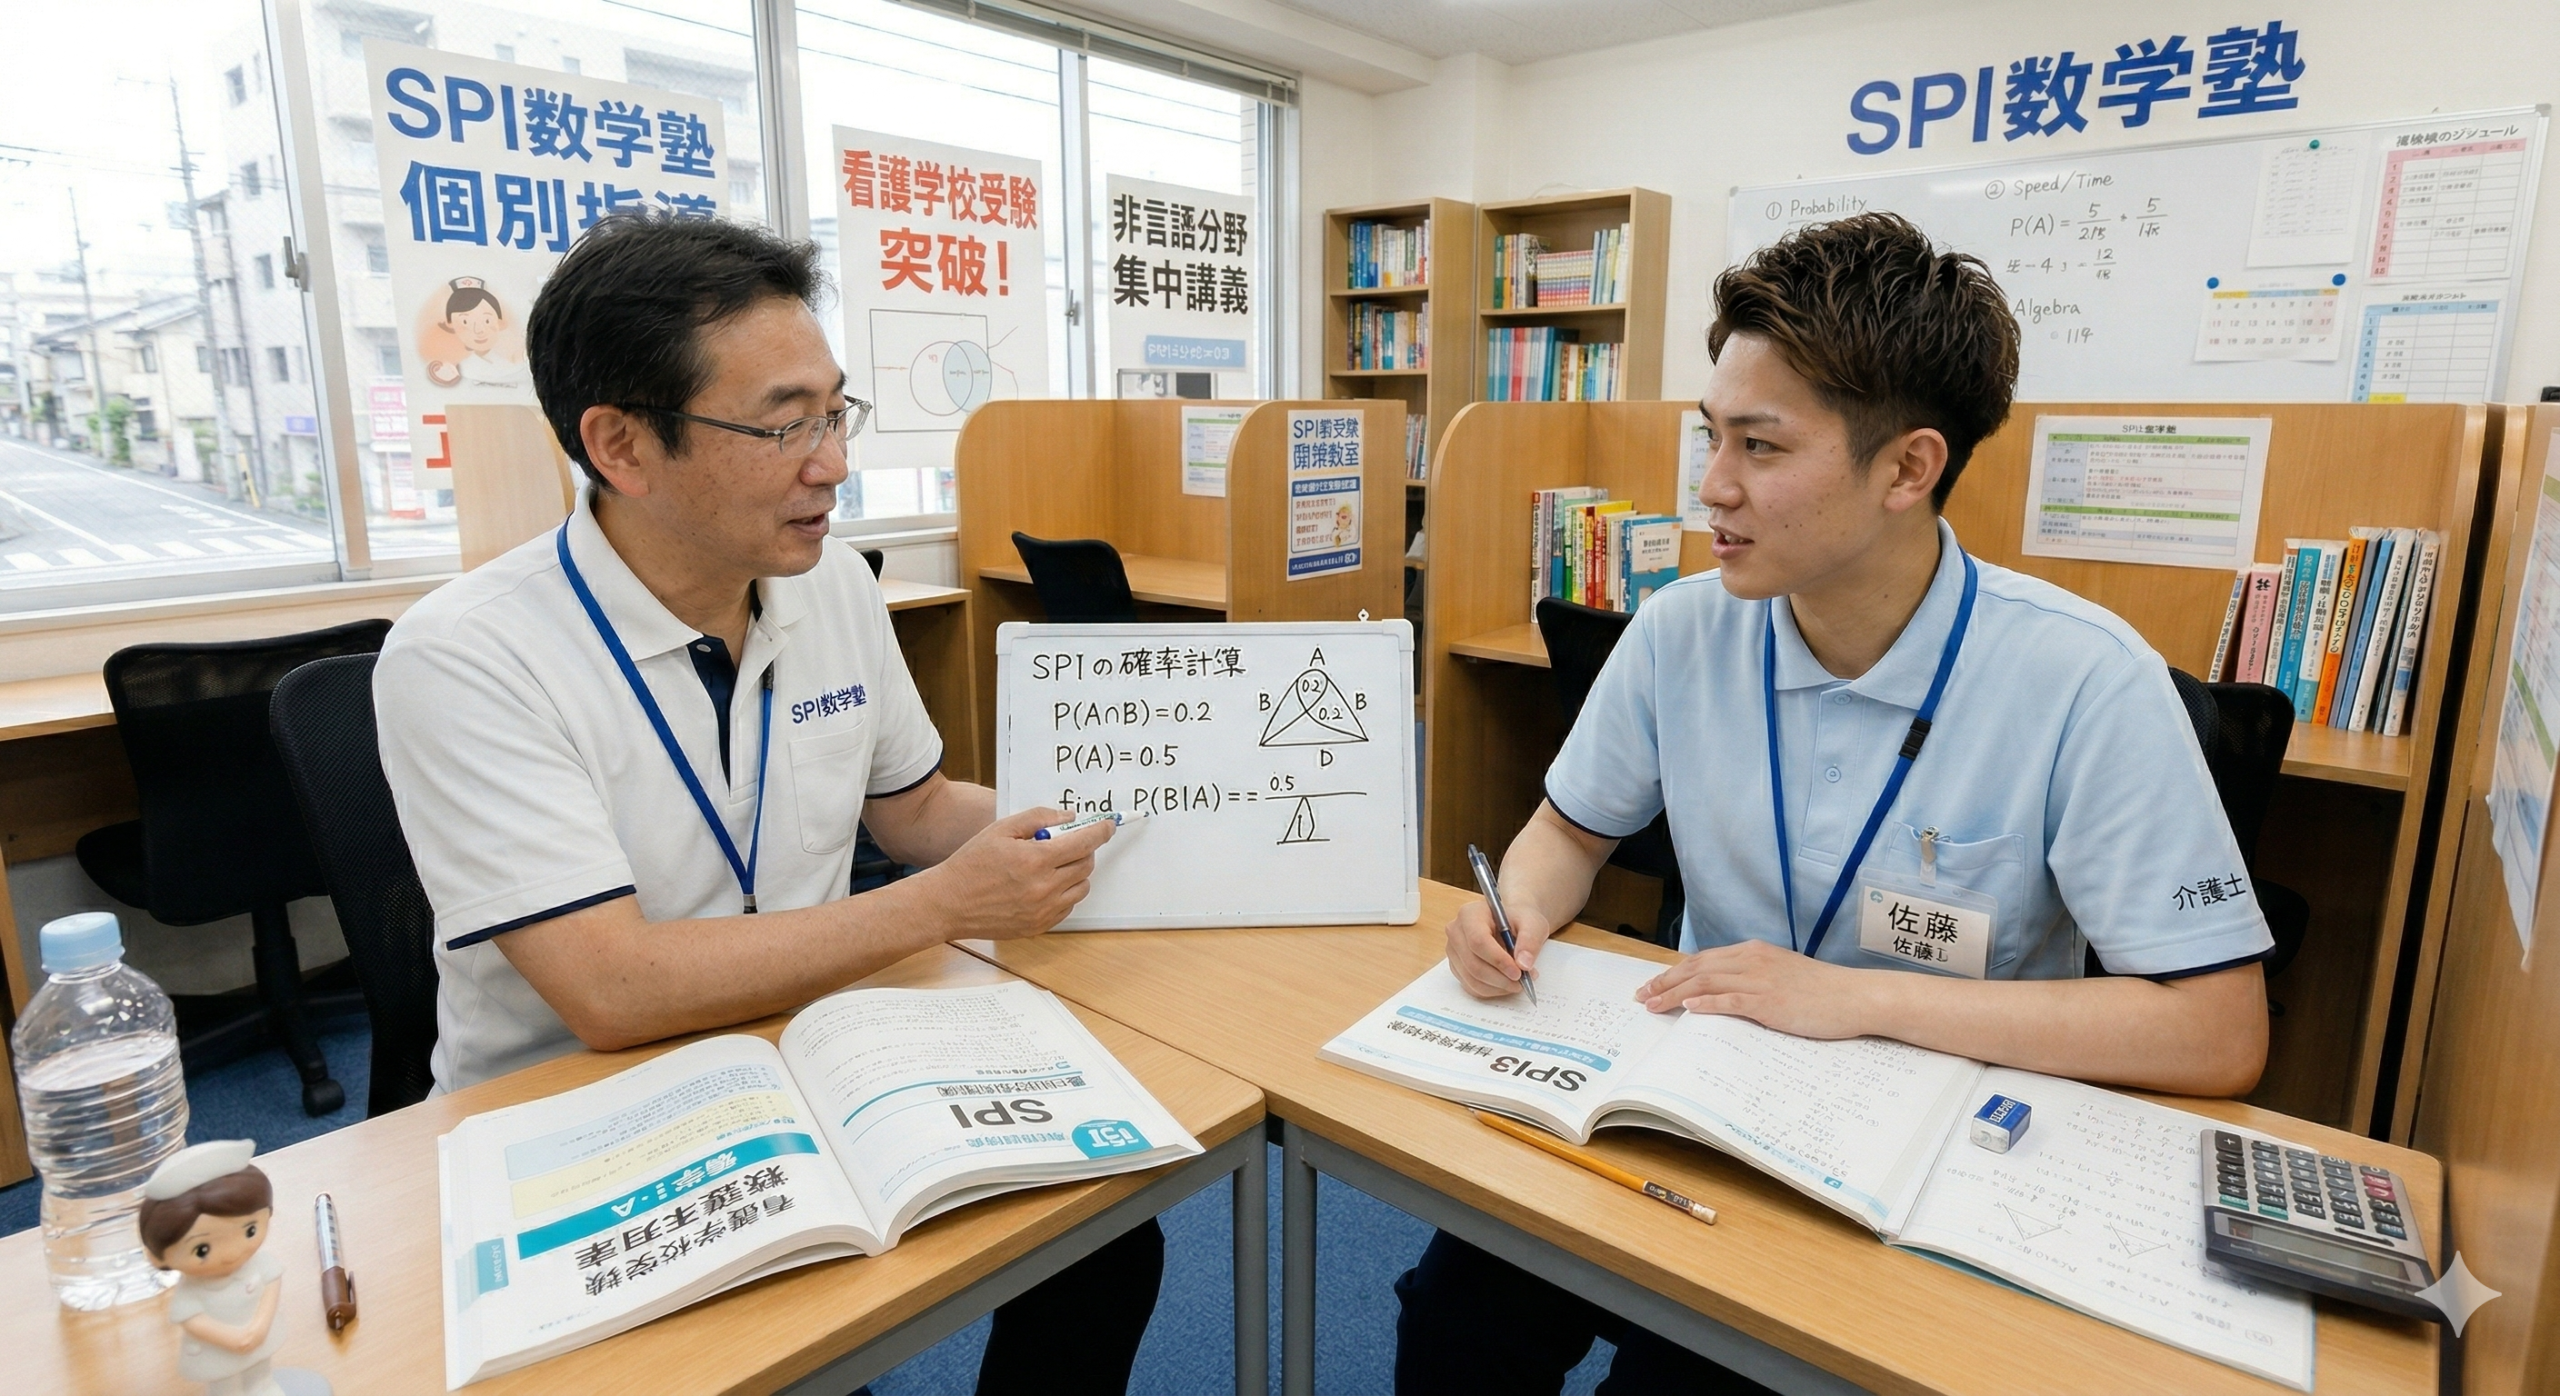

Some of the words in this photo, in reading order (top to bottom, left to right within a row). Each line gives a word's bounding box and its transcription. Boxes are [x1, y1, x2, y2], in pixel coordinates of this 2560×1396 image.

[1846, 19, 2306, 156] SPI数学塾
[386, 67, 716, 180] SPI数学塾
[842, 149, 1038, 230] 看護学校受験
[2013, 170, 2114, 200] Speed/Time
[1113, 253, 1248, 315] 集中講義
[2013, 298, 2081, 325] Algebra
[1310, 647, 1326, 666] A
[791, 684, 867, 724] SPI数学塾
[1259, 693, 1271, 711] B
[1318, 706, 1344, 721] 0.2
[1355, 693, 1367, 711] B
[1319, 749, 1333, 767] D
[1058, 788, 1114, 814] find
[2172, 873, 2246, 911] 介護士
[1888, 901, 1958, 943] 佐藤
[1490, 1056, 1587, 1091] SPI3
[949, 1099, 1053, 1128] SPI
